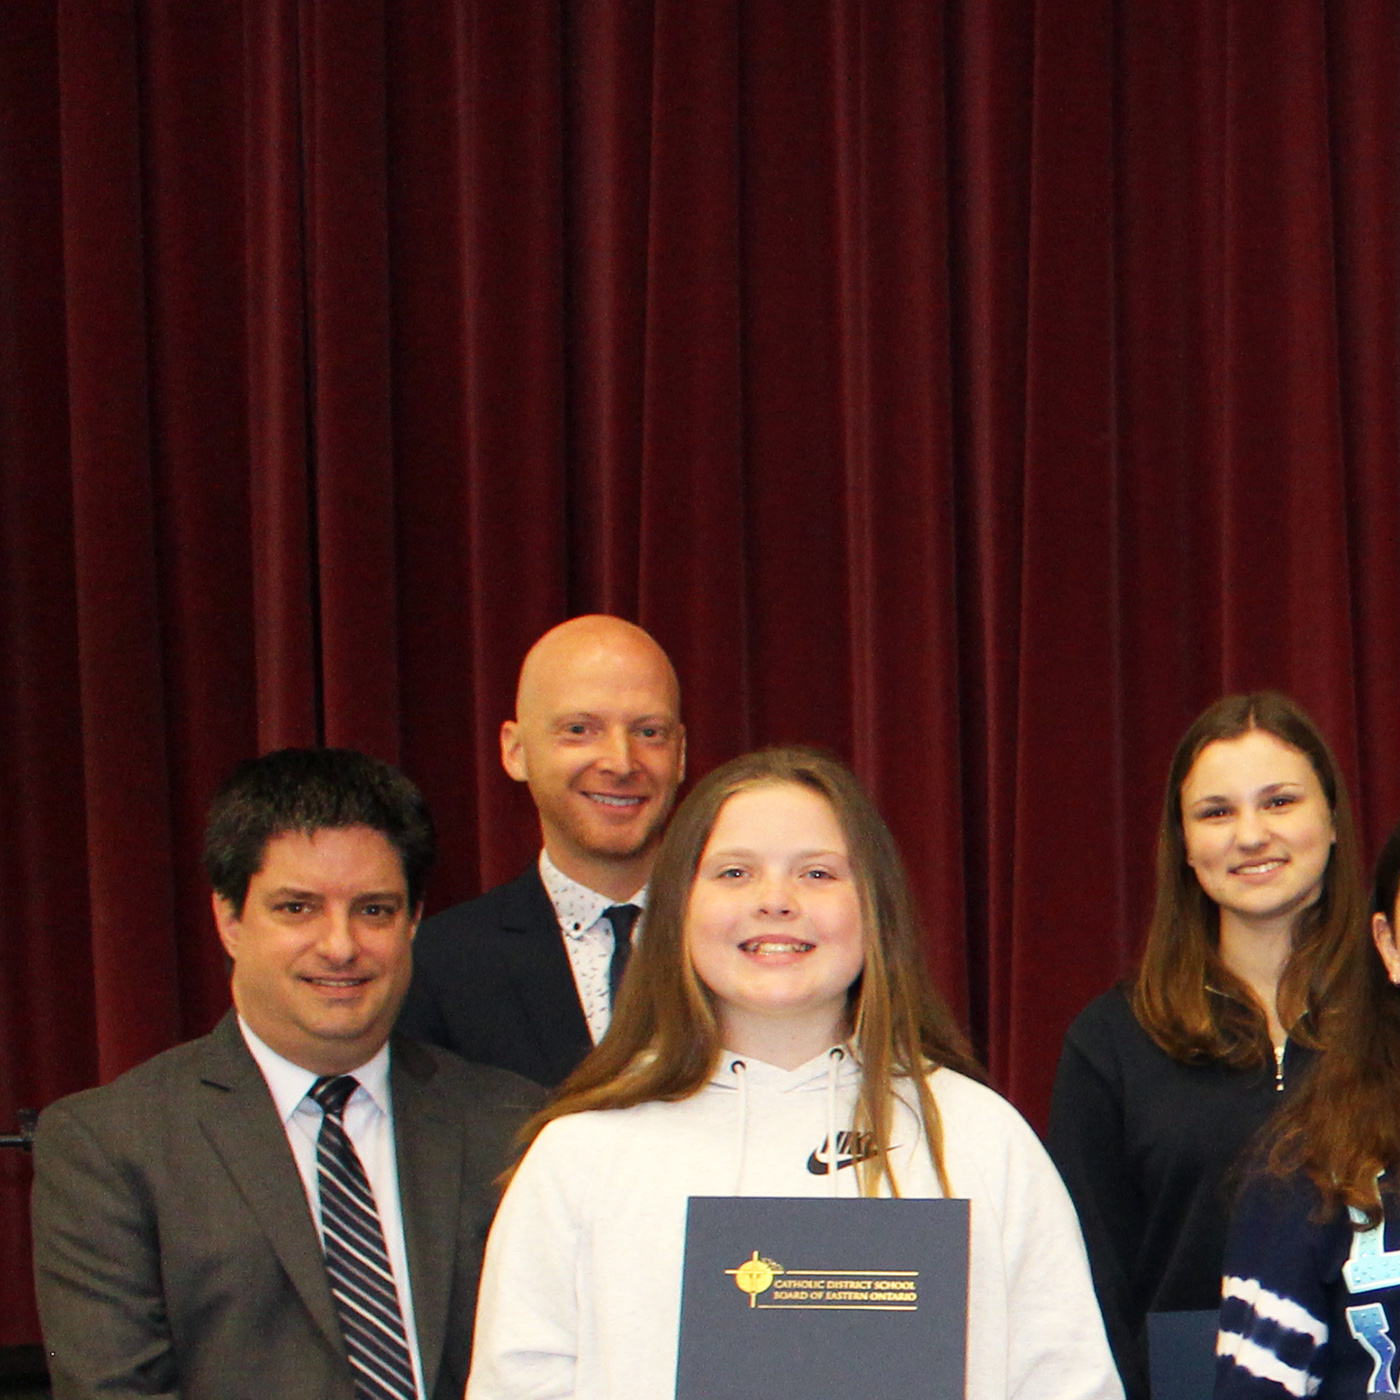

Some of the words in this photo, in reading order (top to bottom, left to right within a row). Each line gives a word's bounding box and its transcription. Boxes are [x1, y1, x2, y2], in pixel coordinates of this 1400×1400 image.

[773, 1279, 825, 1290] CATHOLIC
[826, 1280, 873, 1290] DISTRICT
[873, 1280, 916, 1291] SCHOOL
[772, 1291, 808, 1300] BOARD
[809, 1292, 824, 1300] OF
[825, 1291, 868, 1301] EASTERN
[869, 1292, 918, 1302] ONTARIO
